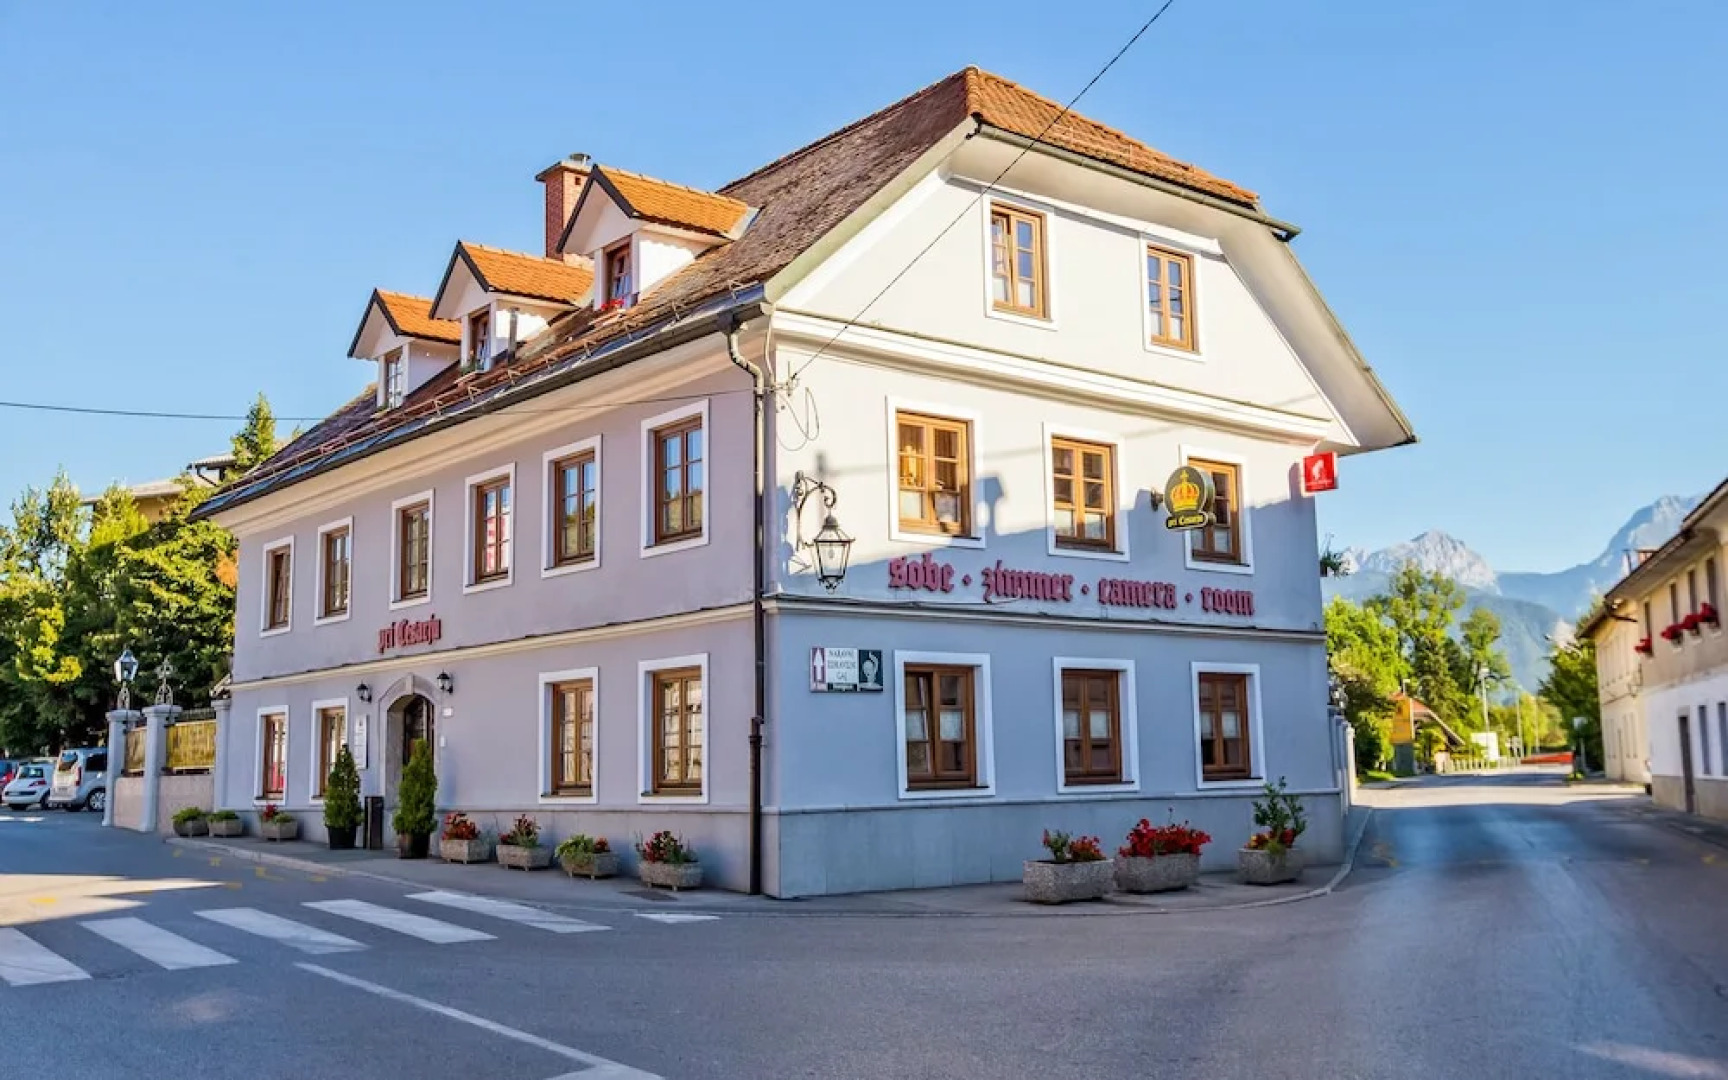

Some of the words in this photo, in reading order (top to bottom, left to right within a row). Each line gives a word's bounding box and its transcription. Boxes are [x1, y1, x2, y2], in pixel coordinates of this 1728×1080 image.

[981, 560, 1074, 603] zimmer
[1098, 578, 1177, 609] camera
[1200, 586, 1254, 615] room
[377, 621, 395, 654] pri
